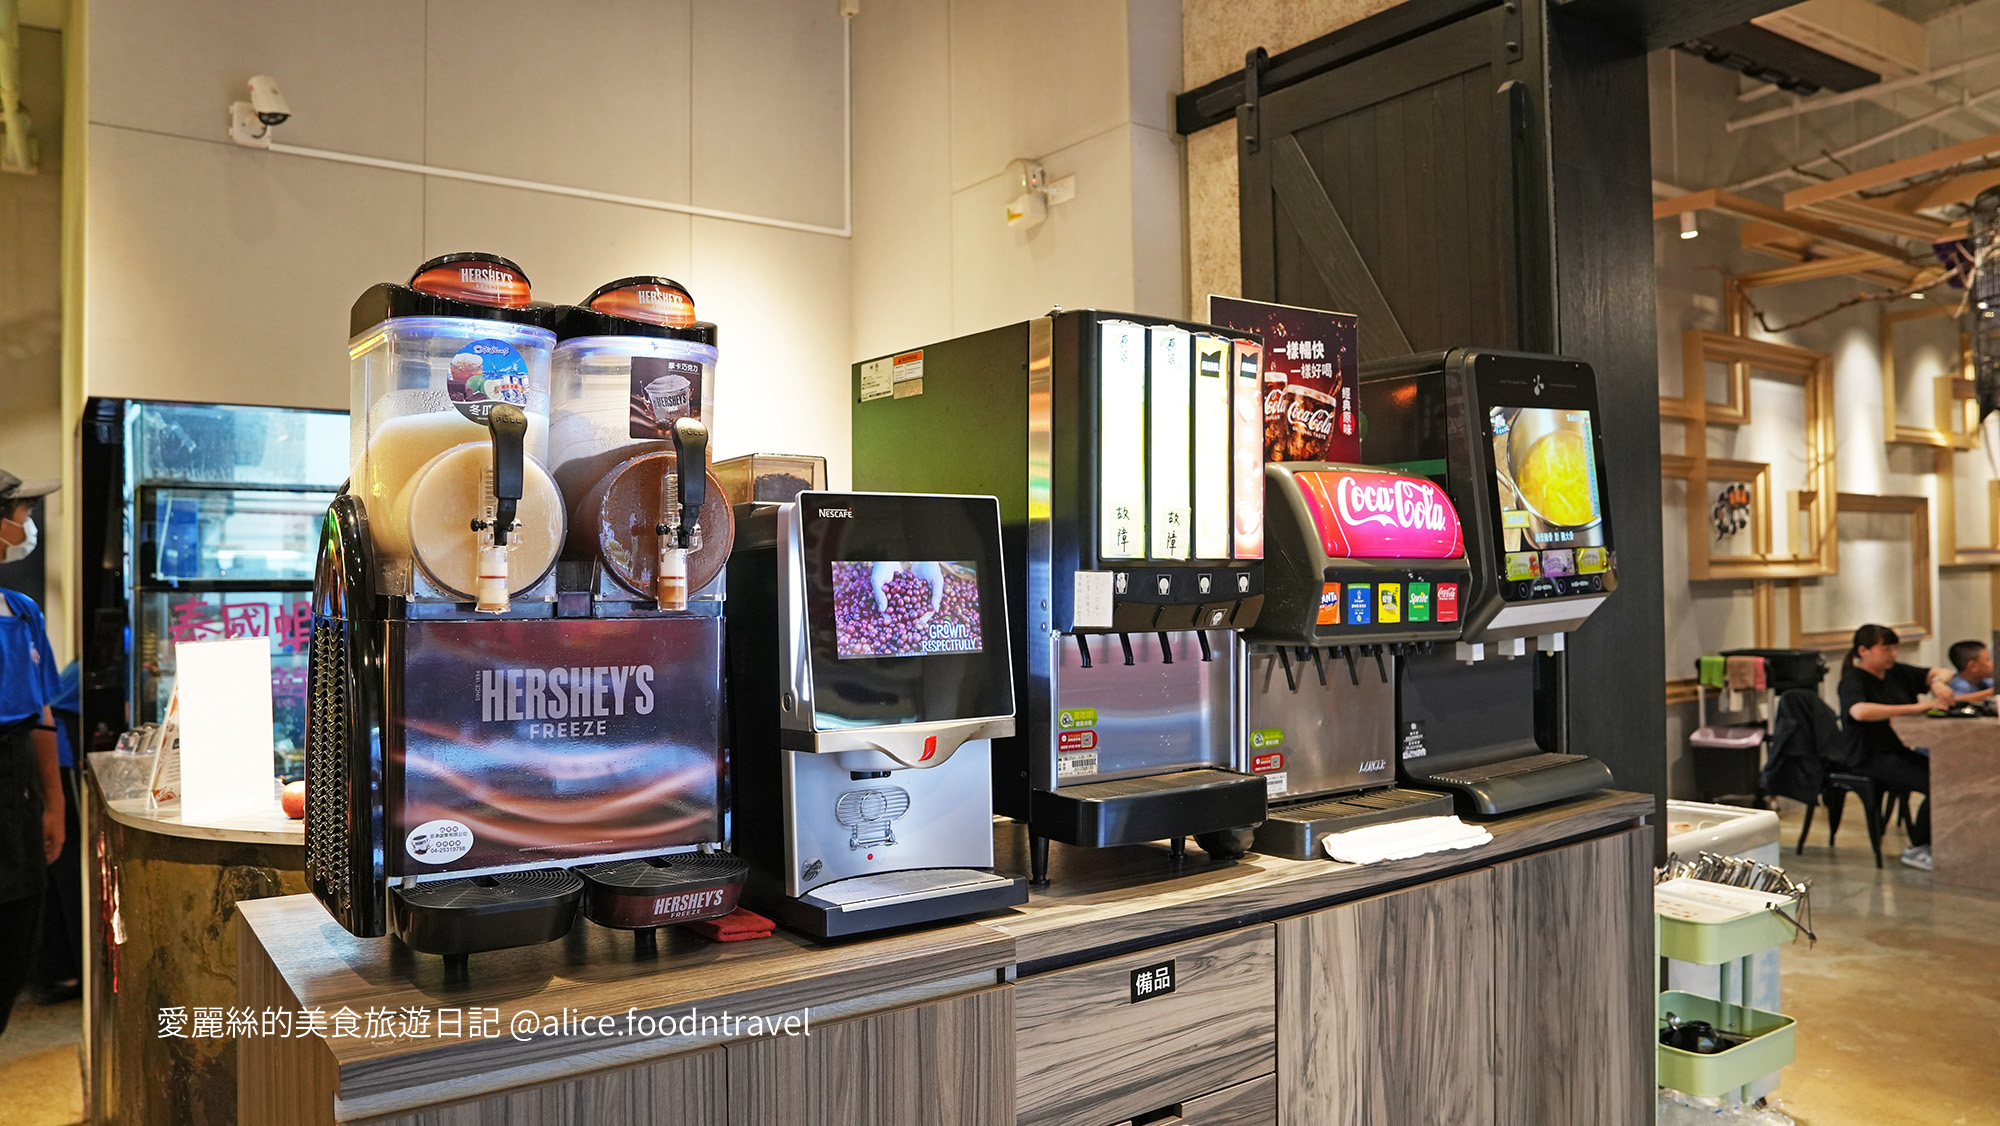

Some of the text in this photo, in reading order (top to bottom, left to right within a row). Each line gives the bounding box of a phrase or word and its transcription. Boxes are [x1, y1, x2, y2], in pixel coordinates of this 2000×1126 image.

[461, 268, 513, 289] HERSHEY'S
[638, 290, 684, 310] HERSHEY'S
[1273, 340, 1325, 360] 一樣暢快
[668, 362, 698, 372] 摩卡巧克力
[1290, 363, 1333, 379] 一樣好喝
[1287, 401, 1334, 435] Coca-Cola
[1341, 387, 1352, 436] 經典原味
[1337, 476, 1446, 531] Coca-Cola
[1116, 506, 1130, 553] 故障
[1166, 511, 1180, 557] 故障
[1320, 591, 1338, 604] ANTA
[1410, 591, 1428, 605] Sprite
[482, 665, 655, 722] HERSHEY'S
[529, 720, 607, 739] FREEZE
[654, 889, 724, 915] HERSHEY'S
[670, 908, 701, 918] FREEZE
[1136, 967, 1170, 996] 備品
